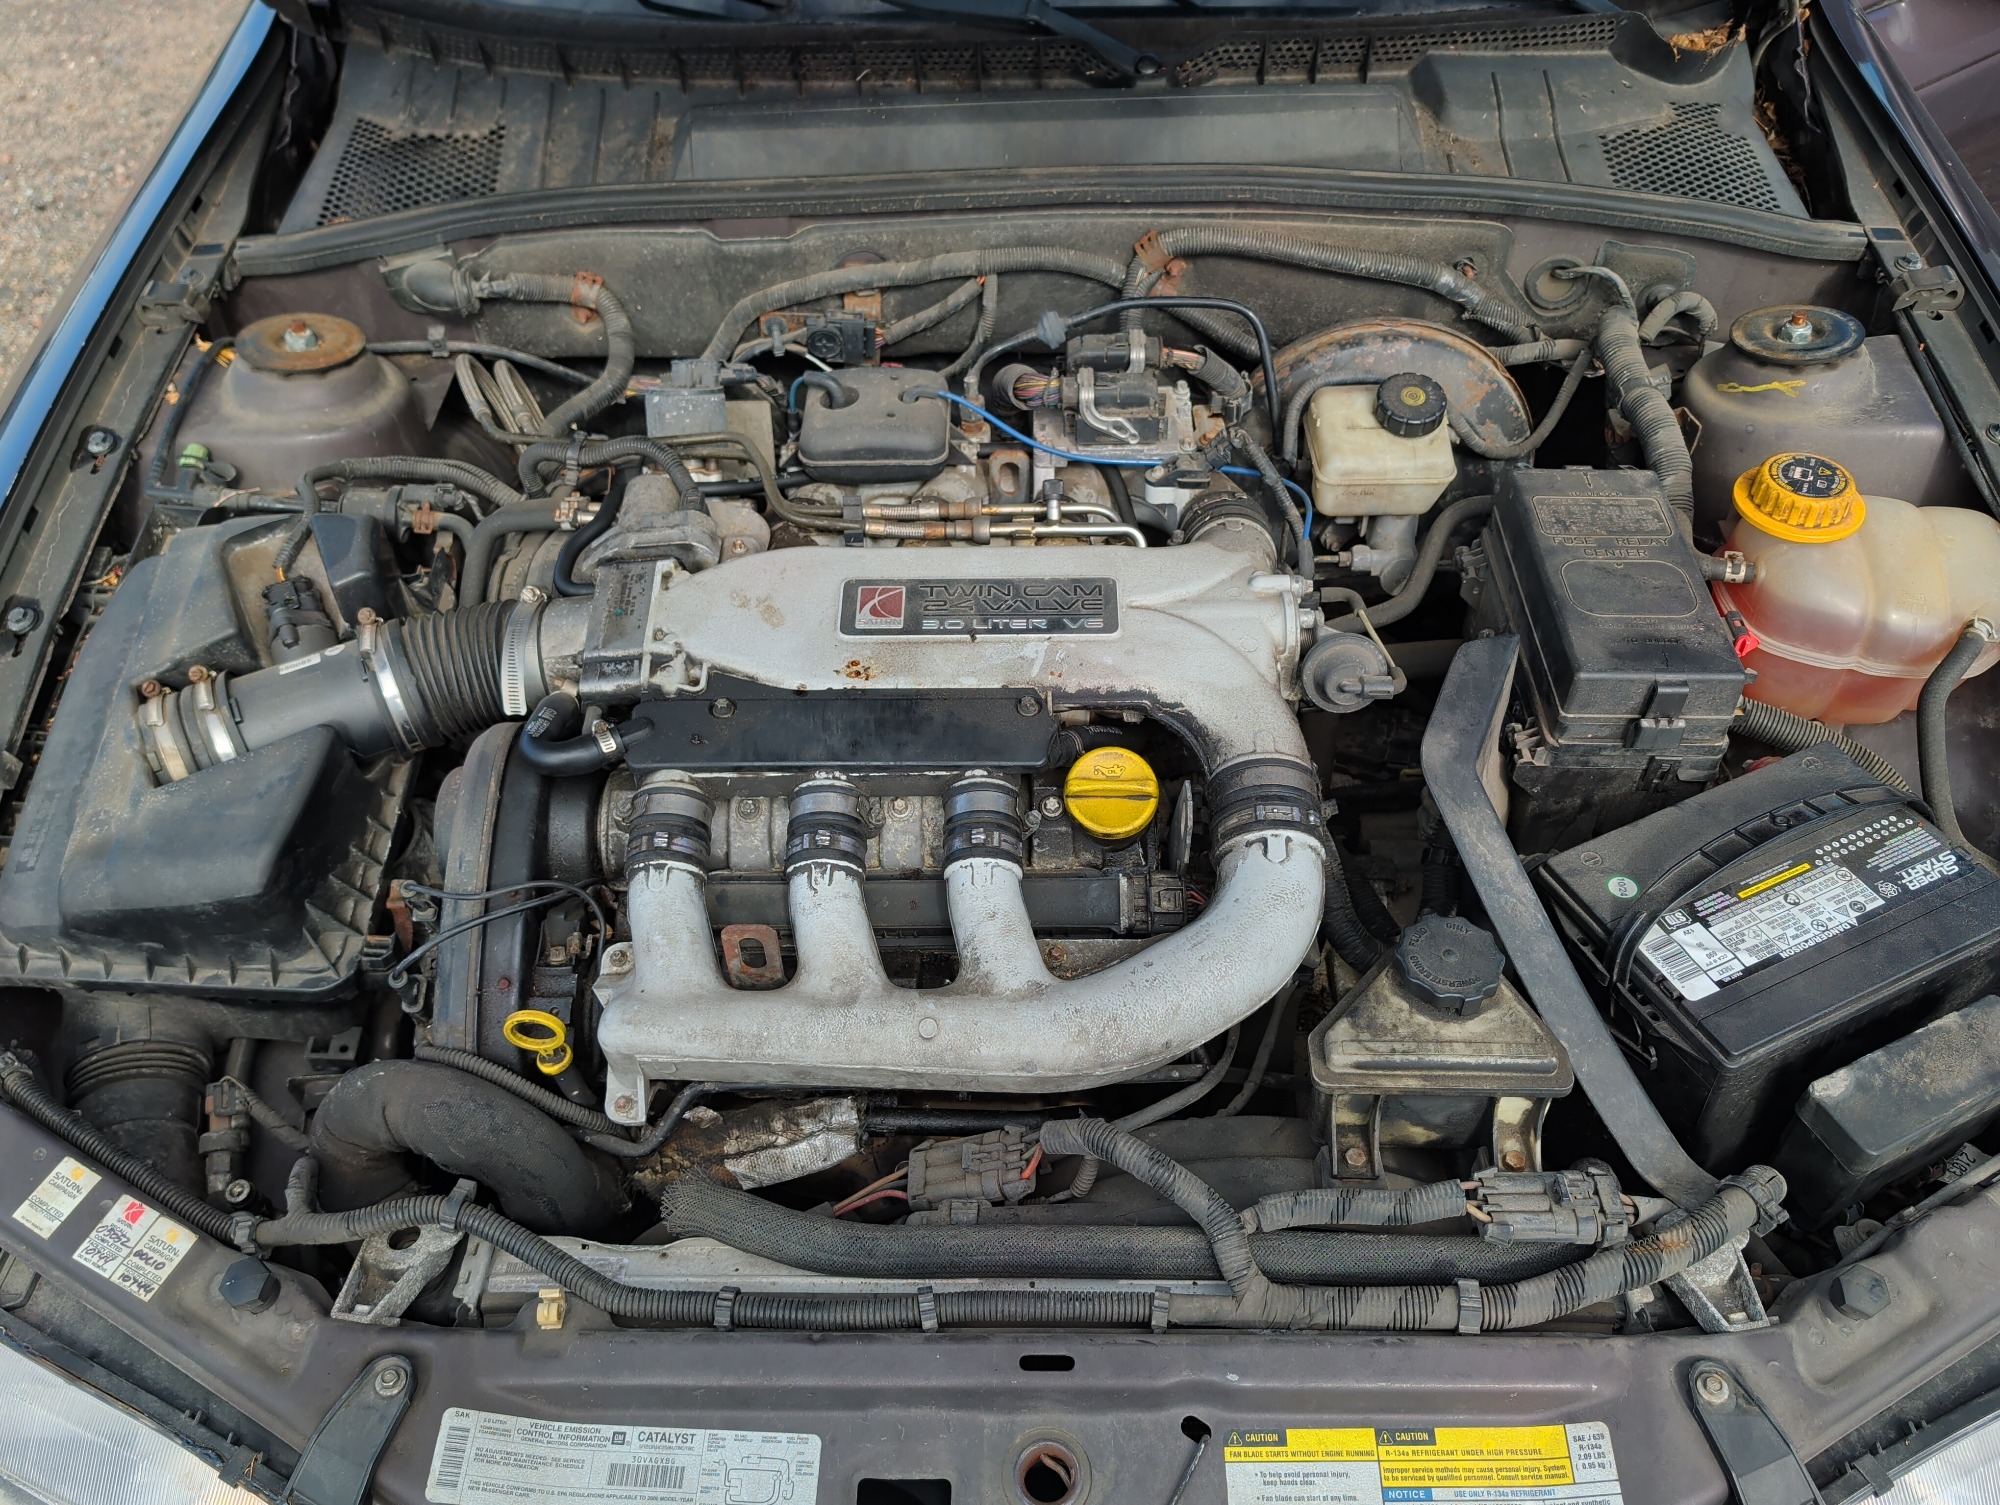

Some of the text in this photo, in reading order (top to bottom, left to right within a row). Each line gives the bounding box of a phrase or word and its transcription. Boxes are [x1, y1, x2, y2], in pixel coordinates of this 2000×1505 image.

[1552, 536, 1669, 547] FUSE RELAY
[1583, 548, 1648, 557] CENTER
[919, 584, 1103, 598] TWIN CAM
[922, 599, 1103, 612] 24 VALVE
[857, 618, 903, 627] SATURN
[922, 618, 1104, 630] 3.0 LITER V6
[1900, 849, 1957, 883] START
[1905, 860, 1959, 891] SUPER
[1664, 911, 1686, 926] STD
[1778, 921, 1851, 958] DANGER/POISON
[52, 1171, 83, 1193] SATURN
[47, 1178, 78, 1200] CAMPAIGN
[27, 1202, 45, 1215] FACILITY
[29, 1193, 65, 1218] COMPLETED
[109, 1222, 128, 1235] RECALL
[86, 1239, 106, 1253] FACILITY
[93, 1233, 123, 1253] COMPLETED
[147, 1234, 180, 1256] SATURN
[142, 1242, 175, 1263] CAMPAIGN
[125, 1258, 162, 1283] COMPLETED
[529, 1422, 601, 1434] VEHICLE EMISSION
[517, 1428, 554, 1439] CONTROL
[558, 1433, 611, 1443] INFORMATION
[521, 1436, 545, 1444] GENERAL
[638, 1431, 697, 1444] CATALYST
[1245, 1433, 1279, 1442] CAUTION
[1395, 1432, 1429, 1441] CAUTION
[1572, 1435, 1586, 1443] SAE
[485, 1448, 524, 1458] ADJUSTMENTS
[1385, 1449, 1410, 1457] R-134a
[1412, 1449, 1458, 1457] REFRIGERANT
[1506, 1448, 1542, 1456] PRESSURE
[1579, 1443, 1602, 1451] R-134a
[1265, 1450, 1289, 1458] STARTS
[1290, 1450, 1320, 1458] WITHOUT
[1593, 1451, 1606, 1459] LBS
[1495, 1465, 1521, 1473] personal
[1543, 1464, 1566, 1473] System
[1302, 1471, 1329, 1479] personal
[1427, 1474, 1434, 1482] by
[1435, 1474, 1462, 1482] qualified
[1263, 1479, 1278, 1487] keep
[1388, 1490, 1425, 1499] NOTICE
[1468, 1490, 1485, 1498] ONLY
[1511, 1489, 1556, 1497] REFRIGERANT
